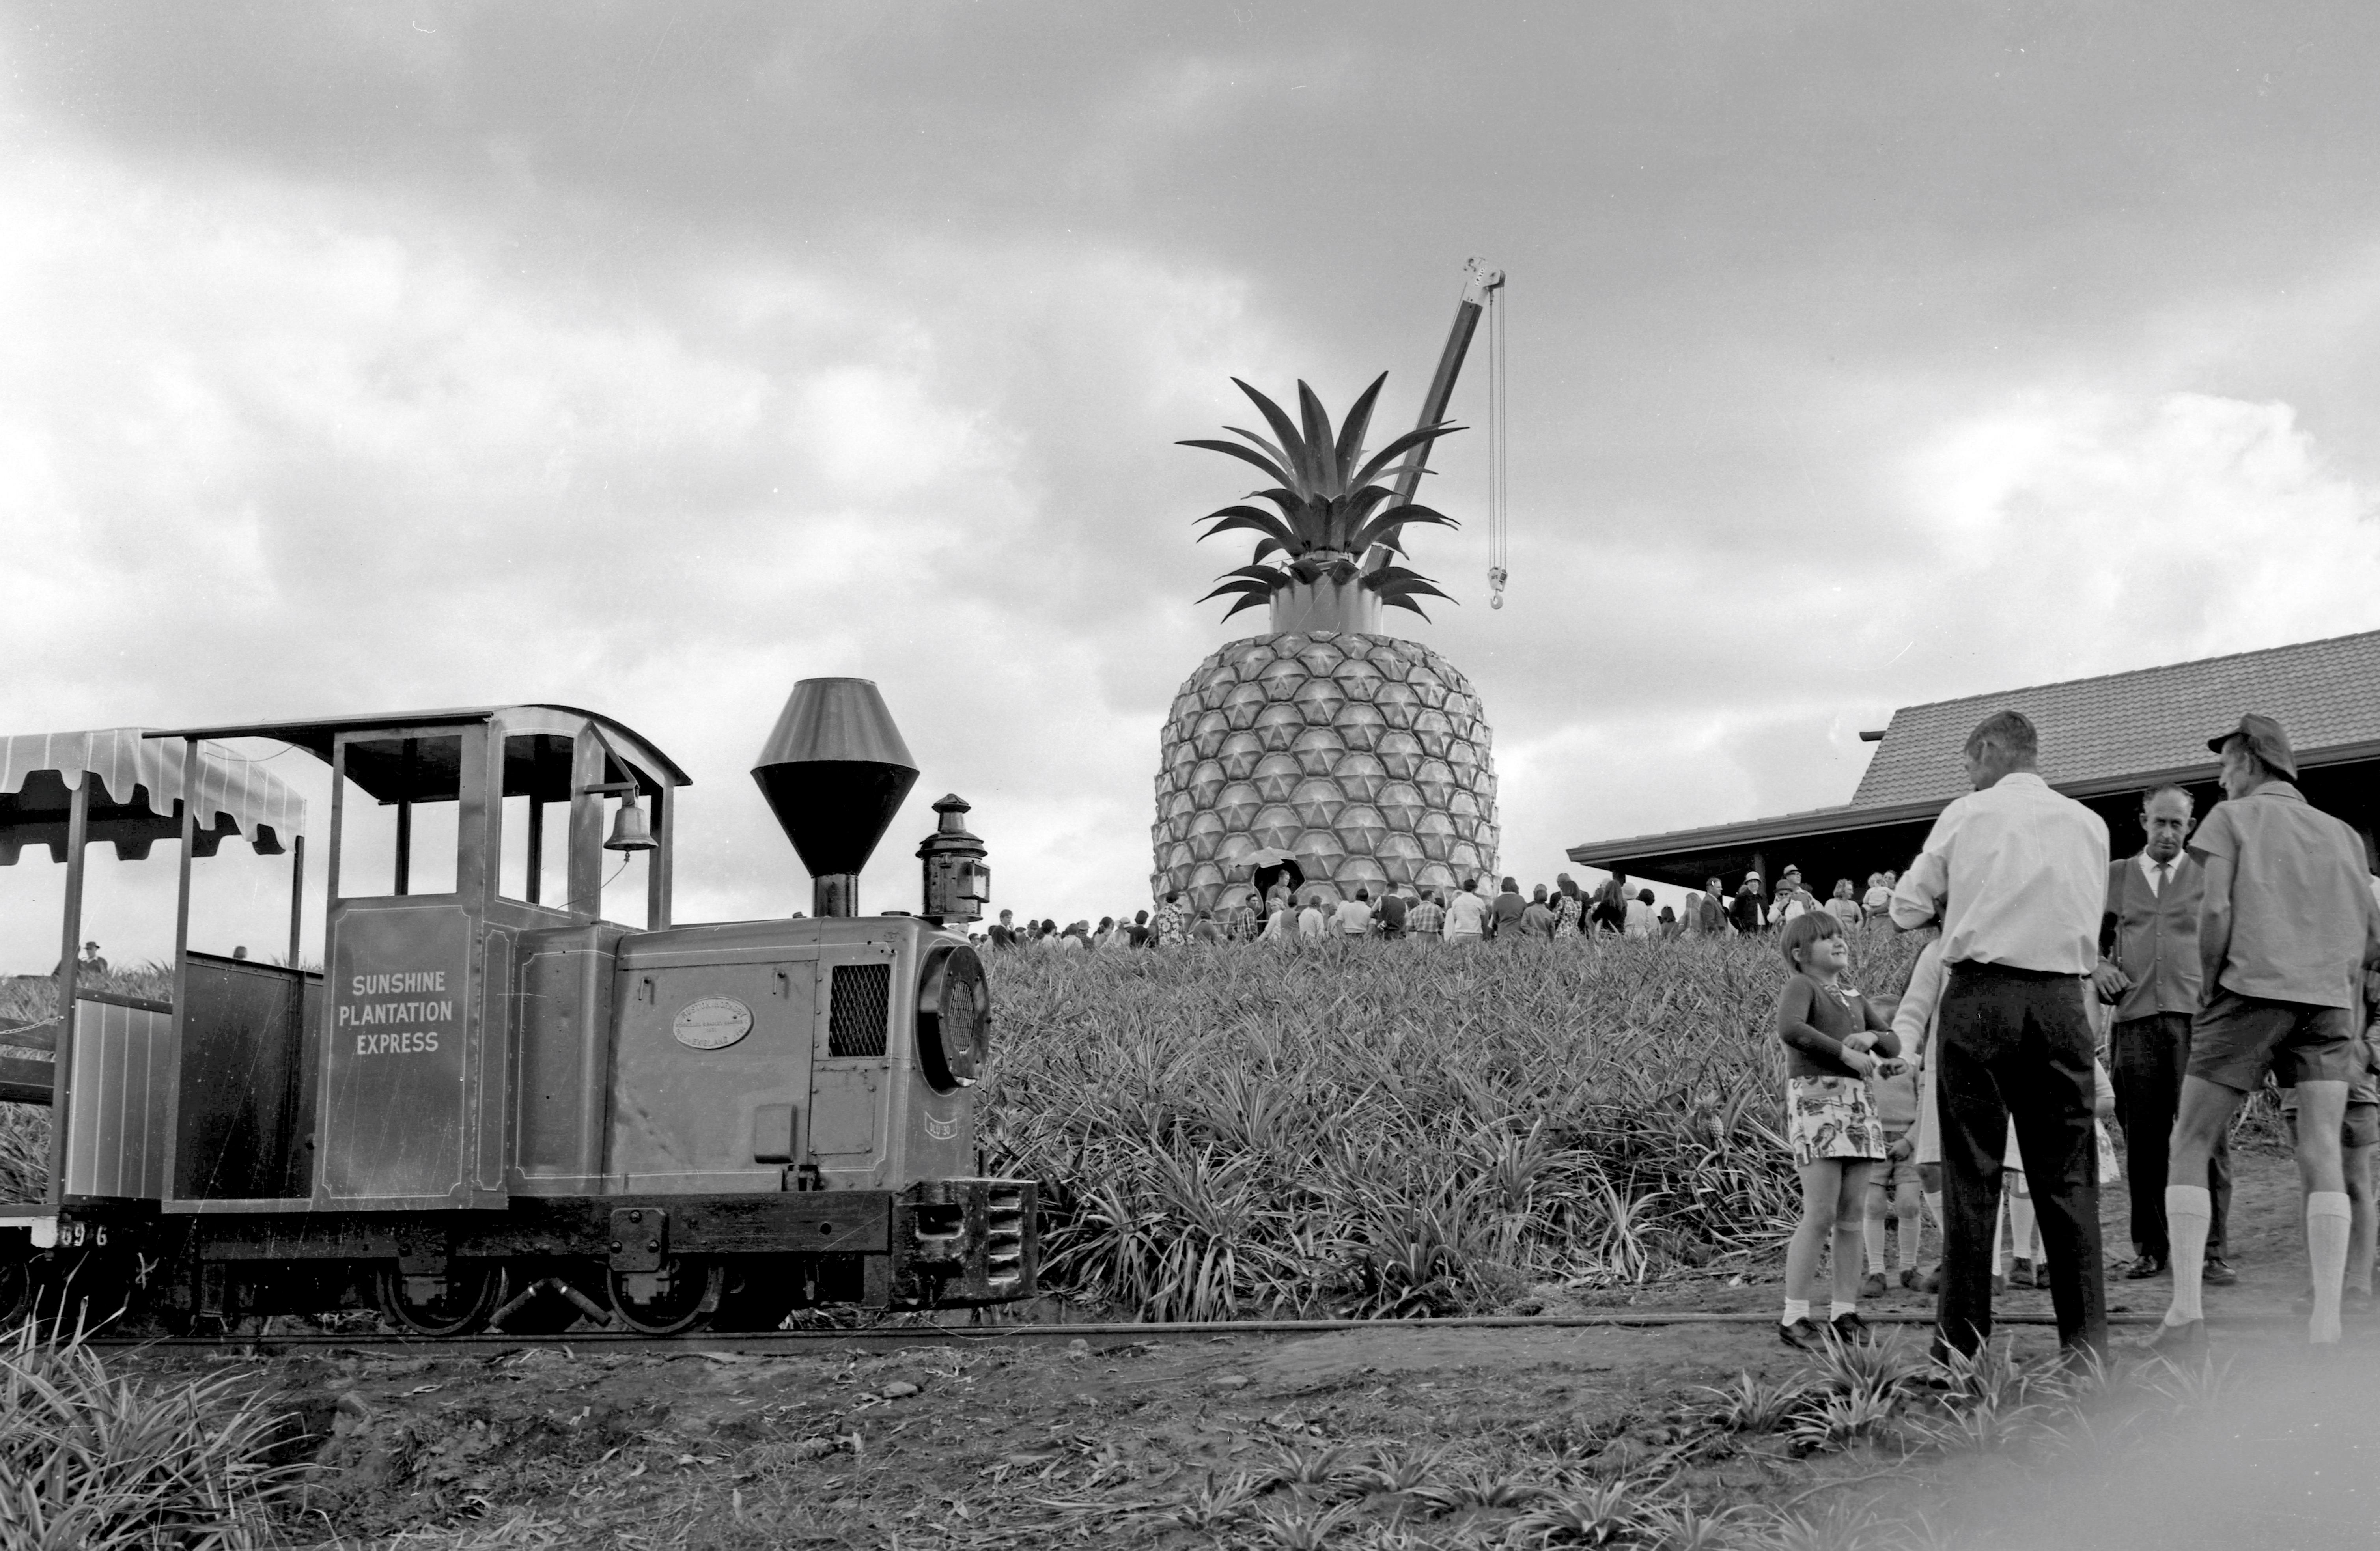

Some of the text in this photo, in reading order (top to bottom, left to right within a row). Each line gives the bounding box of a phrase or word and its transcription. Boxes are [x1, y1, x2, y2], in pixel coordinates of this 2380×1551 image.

[352, 971, 446, 996] SUNSHINE
[339, 1000, 452, 1026] PLANTATION
[357, 1031, 439, 1055] EXPRESS
